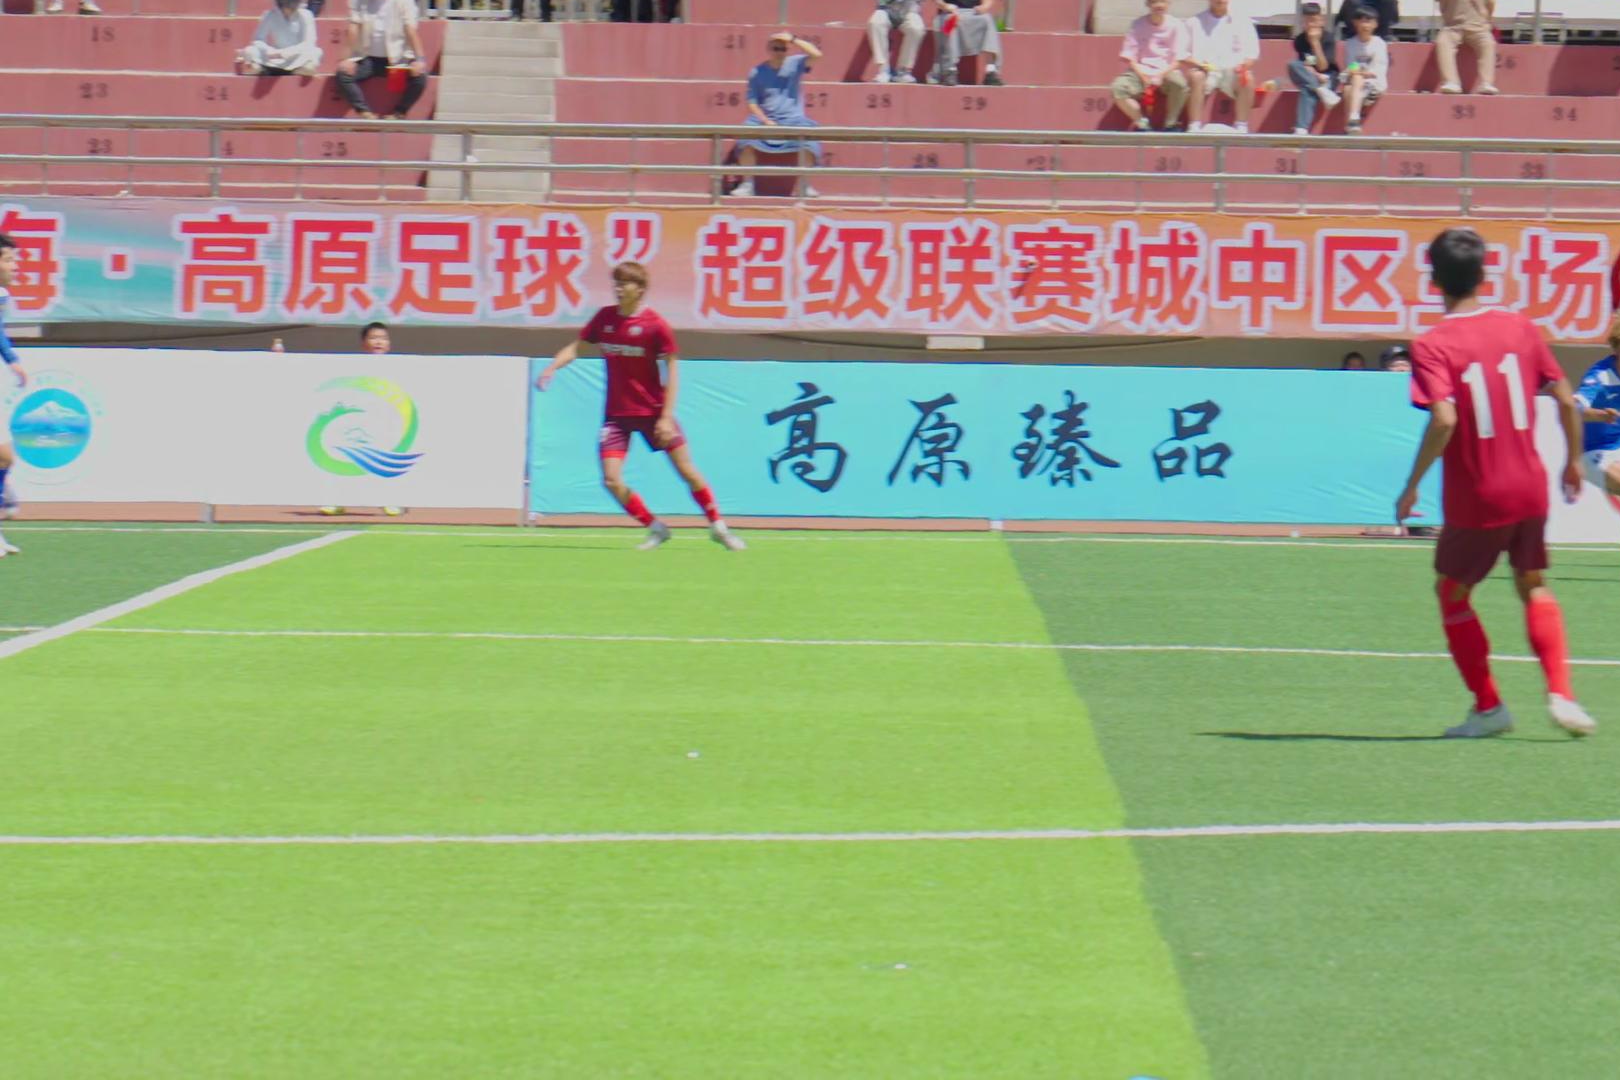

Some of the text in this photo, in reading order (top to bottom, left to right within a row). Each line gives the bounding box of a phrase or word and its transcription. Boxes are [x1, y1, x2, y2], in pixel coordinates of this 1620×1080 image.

[766, 383, 1234, 494] 高原臻品
[1461, 352, 1530, 439] 11
